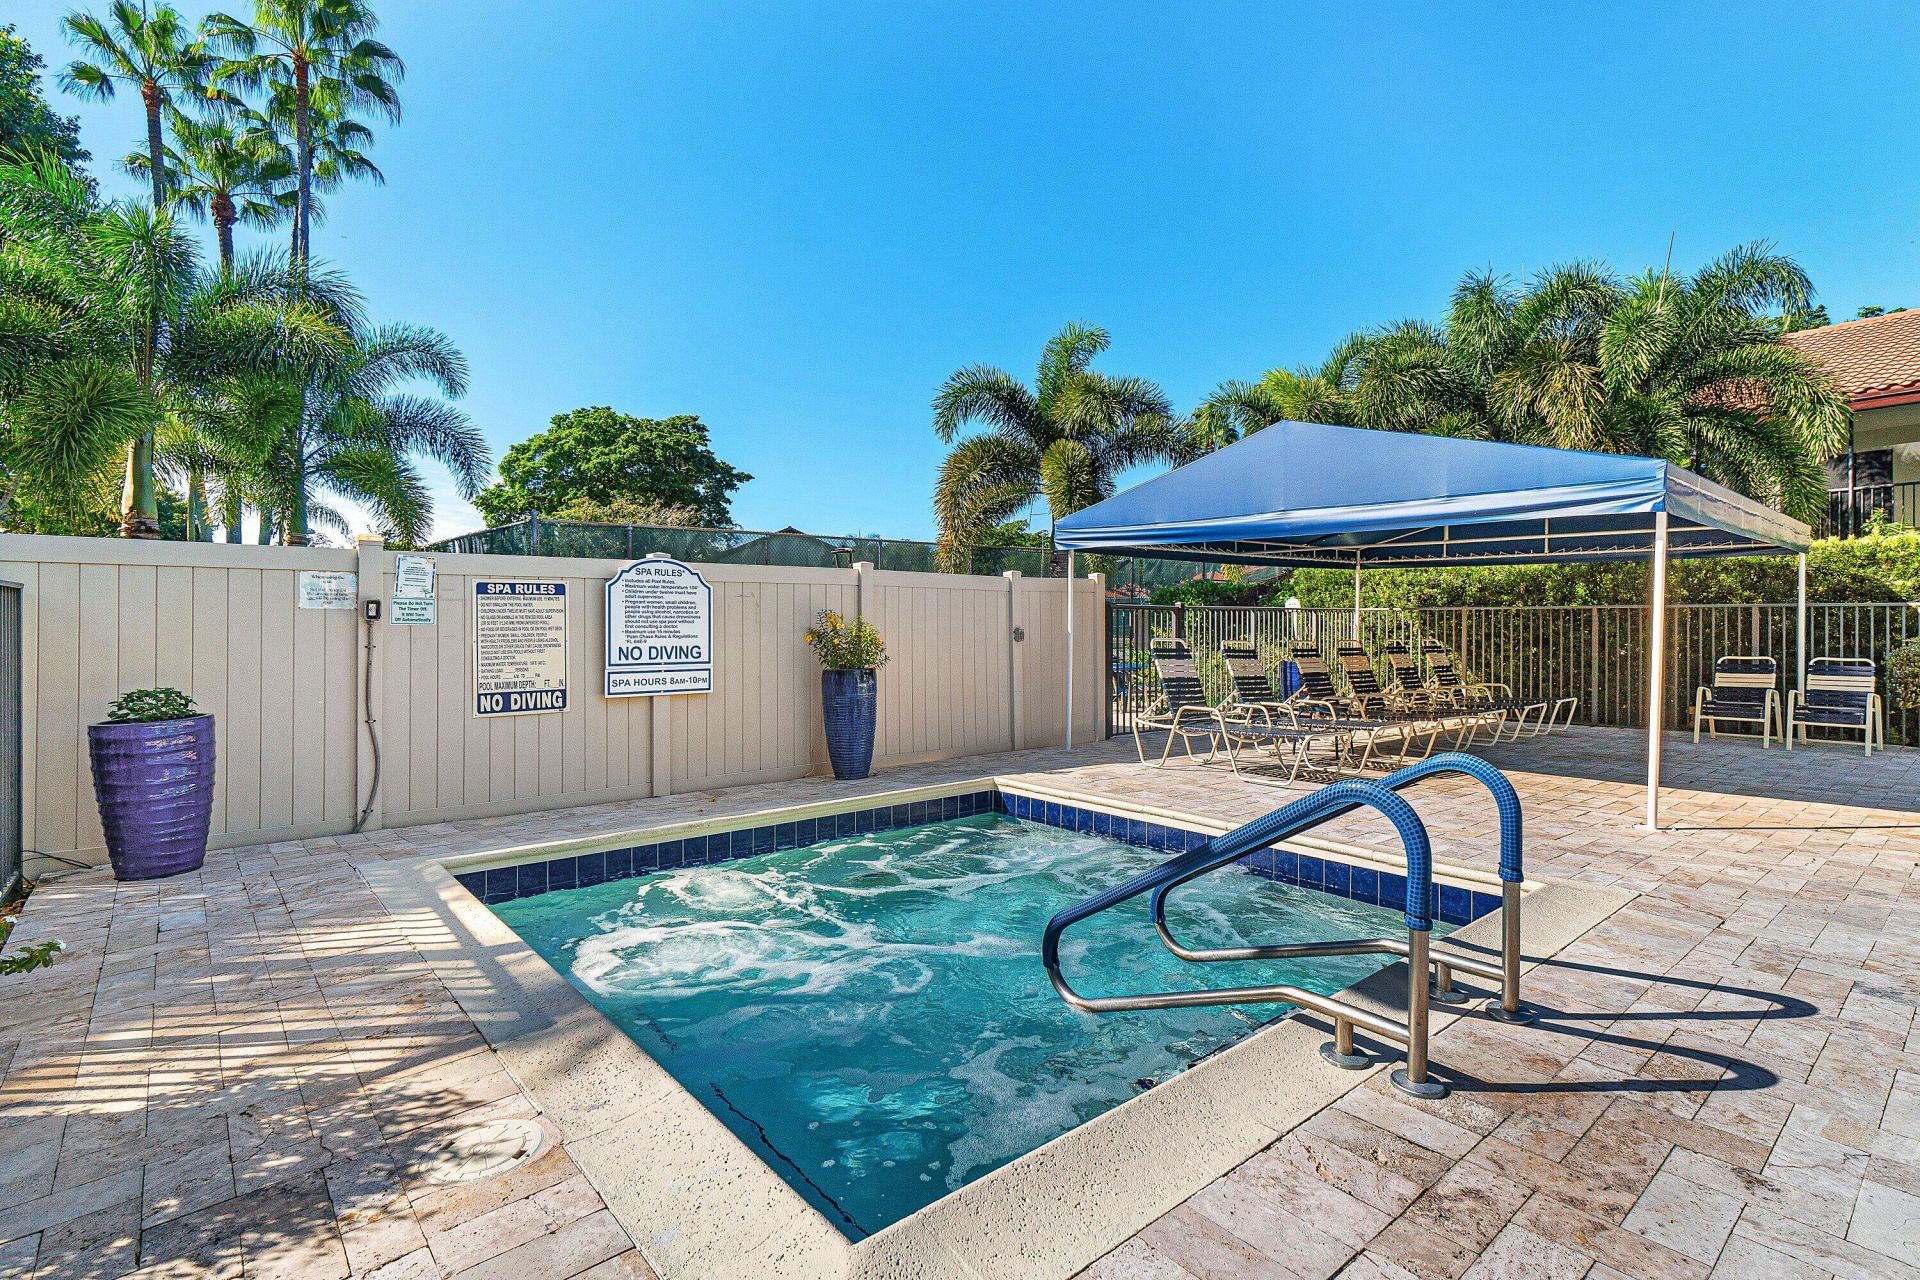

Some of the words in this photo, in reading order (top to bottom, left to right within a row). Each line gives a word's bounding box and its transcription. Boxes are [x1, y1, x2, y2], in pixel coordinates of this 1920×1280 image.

[487, 584, 511, 593] SPA
[516, 584, 555, 594] RULES
[619, 646, 642, 660] NO
[649, 646, 701, 660] DIVING
[480, 694, 503, 711] NO
[511, 692, 562, 709] DIVING
